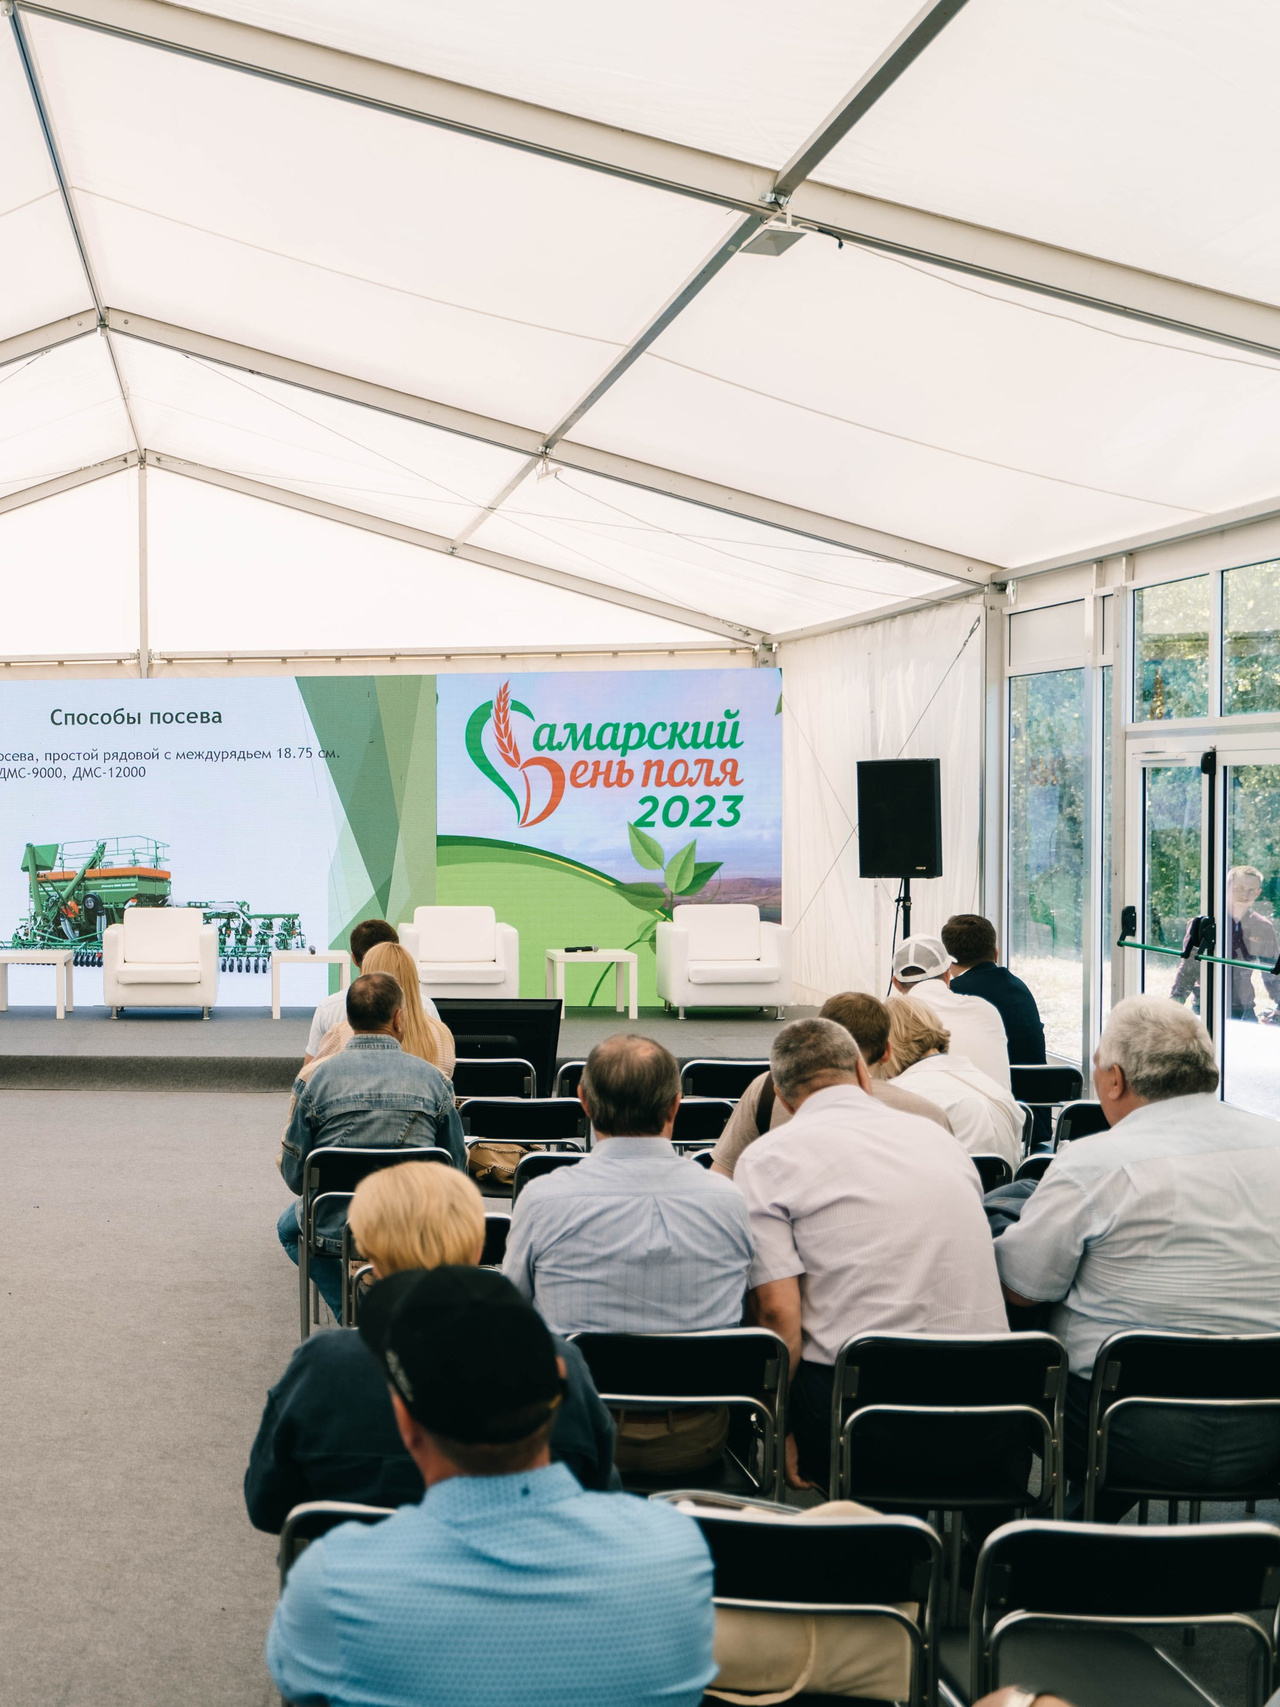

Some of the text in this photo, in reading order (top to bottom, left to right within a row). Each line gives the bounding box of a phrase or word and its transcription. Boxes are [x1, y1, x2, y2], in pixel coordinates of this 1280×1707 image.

[50, 708, 223, 726] Способы посева
[44, 748, 99, 764] простой
[103, 748, 160, 763] рядовой
[164, 750, 172, 760] с
[175, 750, 271, 763] междурядьем
[277, 747, 313, 759] 18.75
[318, 750, 340, 759] см.
[72, 766, 146, 781] ДМС-12000
[642, 758, 744, 788] поля
[634, 795, 744, 828] 2023
